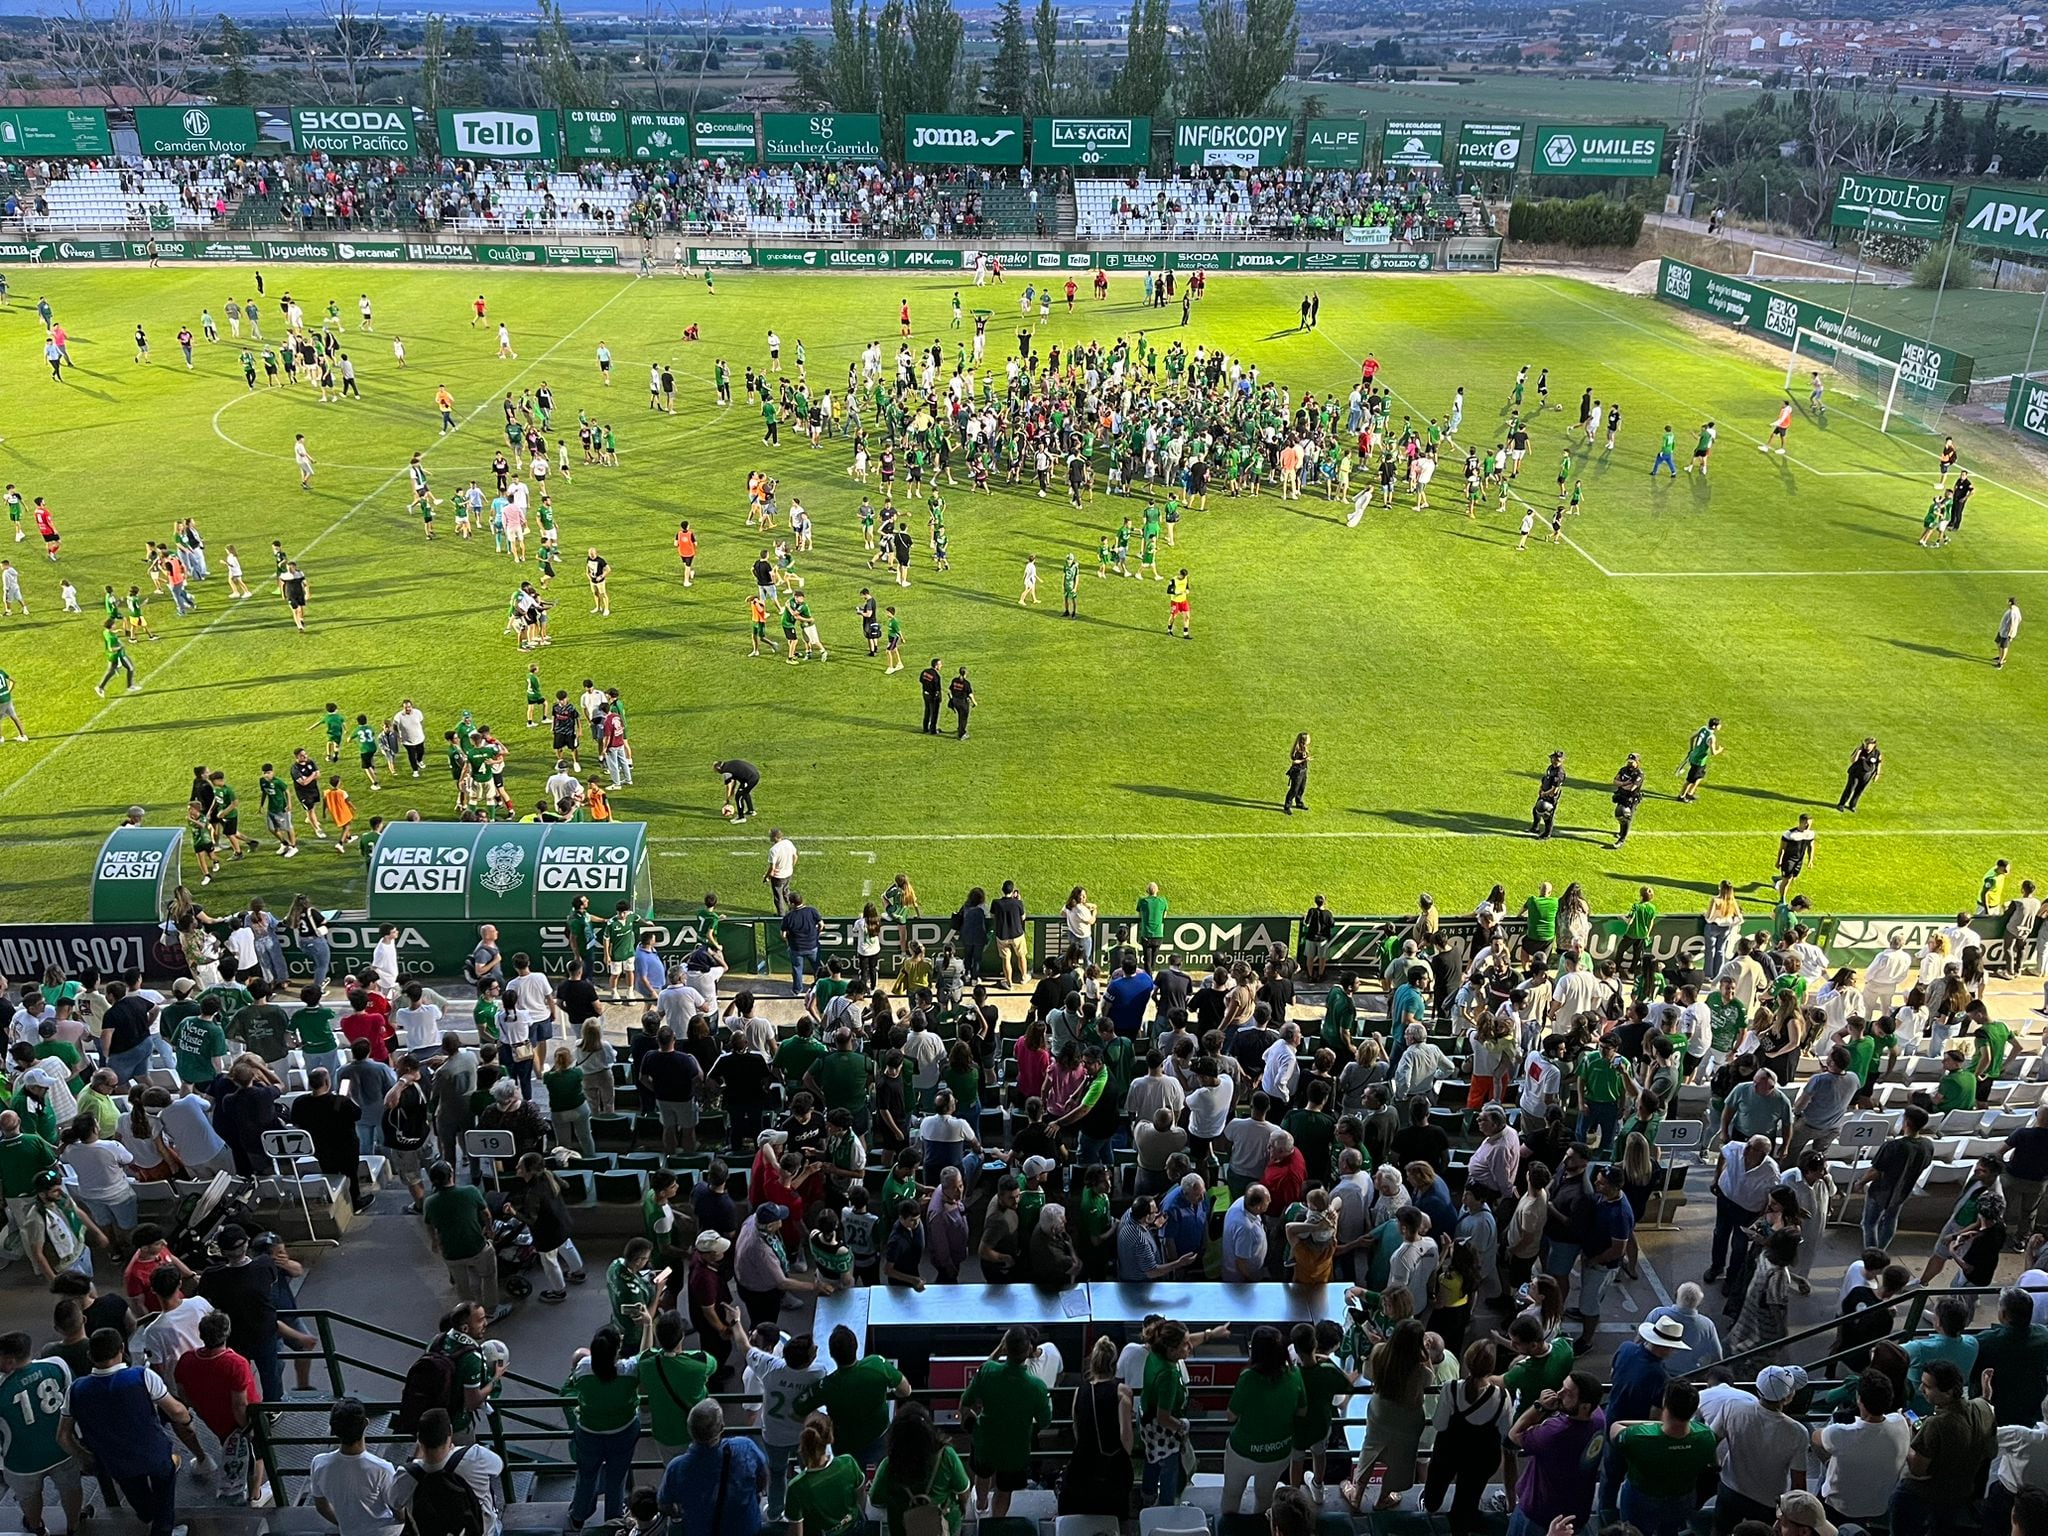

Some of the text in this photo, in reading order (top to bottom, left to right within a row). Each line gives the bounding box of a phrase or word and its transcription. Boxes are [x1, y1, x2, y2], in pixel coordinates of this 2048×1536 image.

[571, 111, 617, 122] CD TOLEDO
[657, 116, 685, 126] TOLEDO
[462, 121, 534, 146] Tello
[1311, 132, 1360, 144] ALPE
[154, 140, 247, 152] Camden Motor
[302, 135, 408, 150] Motor Pacífico
[1459, 142, 1494, 155] next
[1583, 139, 1656, 156] UMILES
[1863, 219, 1907, 231] ESPAÑA
[1967, 202, 2046, 239] APK
[155, 244, 184, 253] ELENO
[424, 245, 472, 256] HULOMA
[830, 251, 876, 263] alicen
[904, 253, 934, 264] APK
[1038, 254, 1059, 264] Tello
[1068, 255, 1089, 264] Tello
[1666, 278, 1690, 299] CASH
[1766, 313, 1795, 337] CASH
[103, 864, 157, 878] CASH
[543, 867, 624, 888] CASH
[380, 869, 461, 890] CASH
[183, 1021, 208, 1036] Never
[180, 1030, 203, 1045] Waste
[1670, 1127, 1688, 1138] 19
[1854, 1127, 1874, 1138] 21
[271, 1135, 304, 1155] 17
[480, 1137, 500, 1150] 19
[12, 1378, 64, 1425] 18
